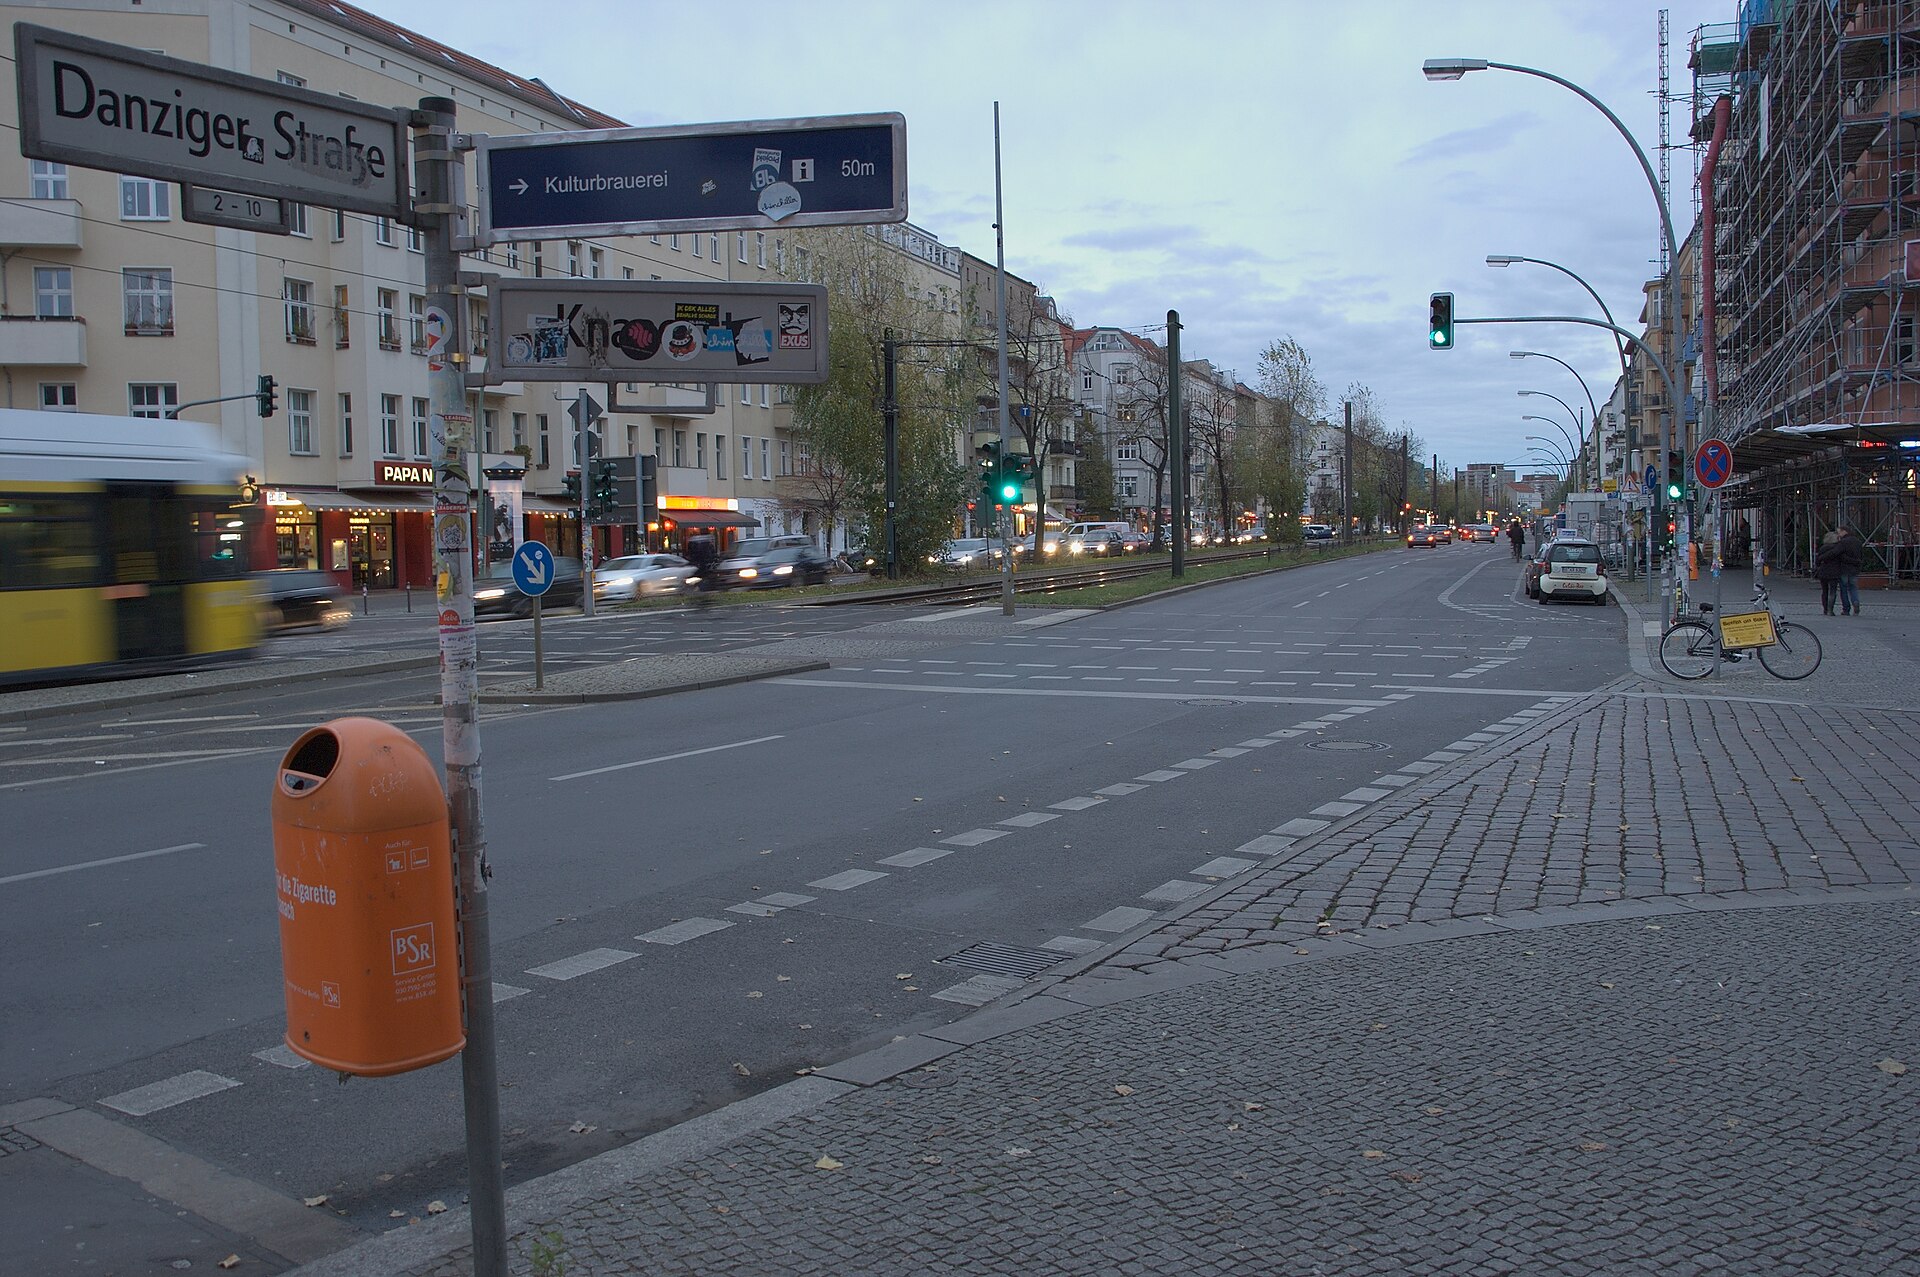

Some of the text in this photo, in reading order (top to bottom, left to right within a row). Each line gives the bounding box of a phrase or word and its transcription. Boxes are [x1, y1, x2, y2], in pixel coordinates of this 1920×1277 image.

[53, 60, 386, 188] Danziger Straße
[544, 170, 669, 193] Kulturbrauerei
[841, 159, 876, 178] 50m
[213, 194, 223, 212] 2
[245, 199, 262, 218] 10
[780, 335, 808, 348] EXUS
[384, 466, 433, 483] PAPA N
[385, 841, 401, 849] Auch
[292, 876, 336, 906] Zigarette
[396, 935, 431, 964] BSR
[395, 977, 416, 987] Service
[324, 985, 338, 1004] BSR
